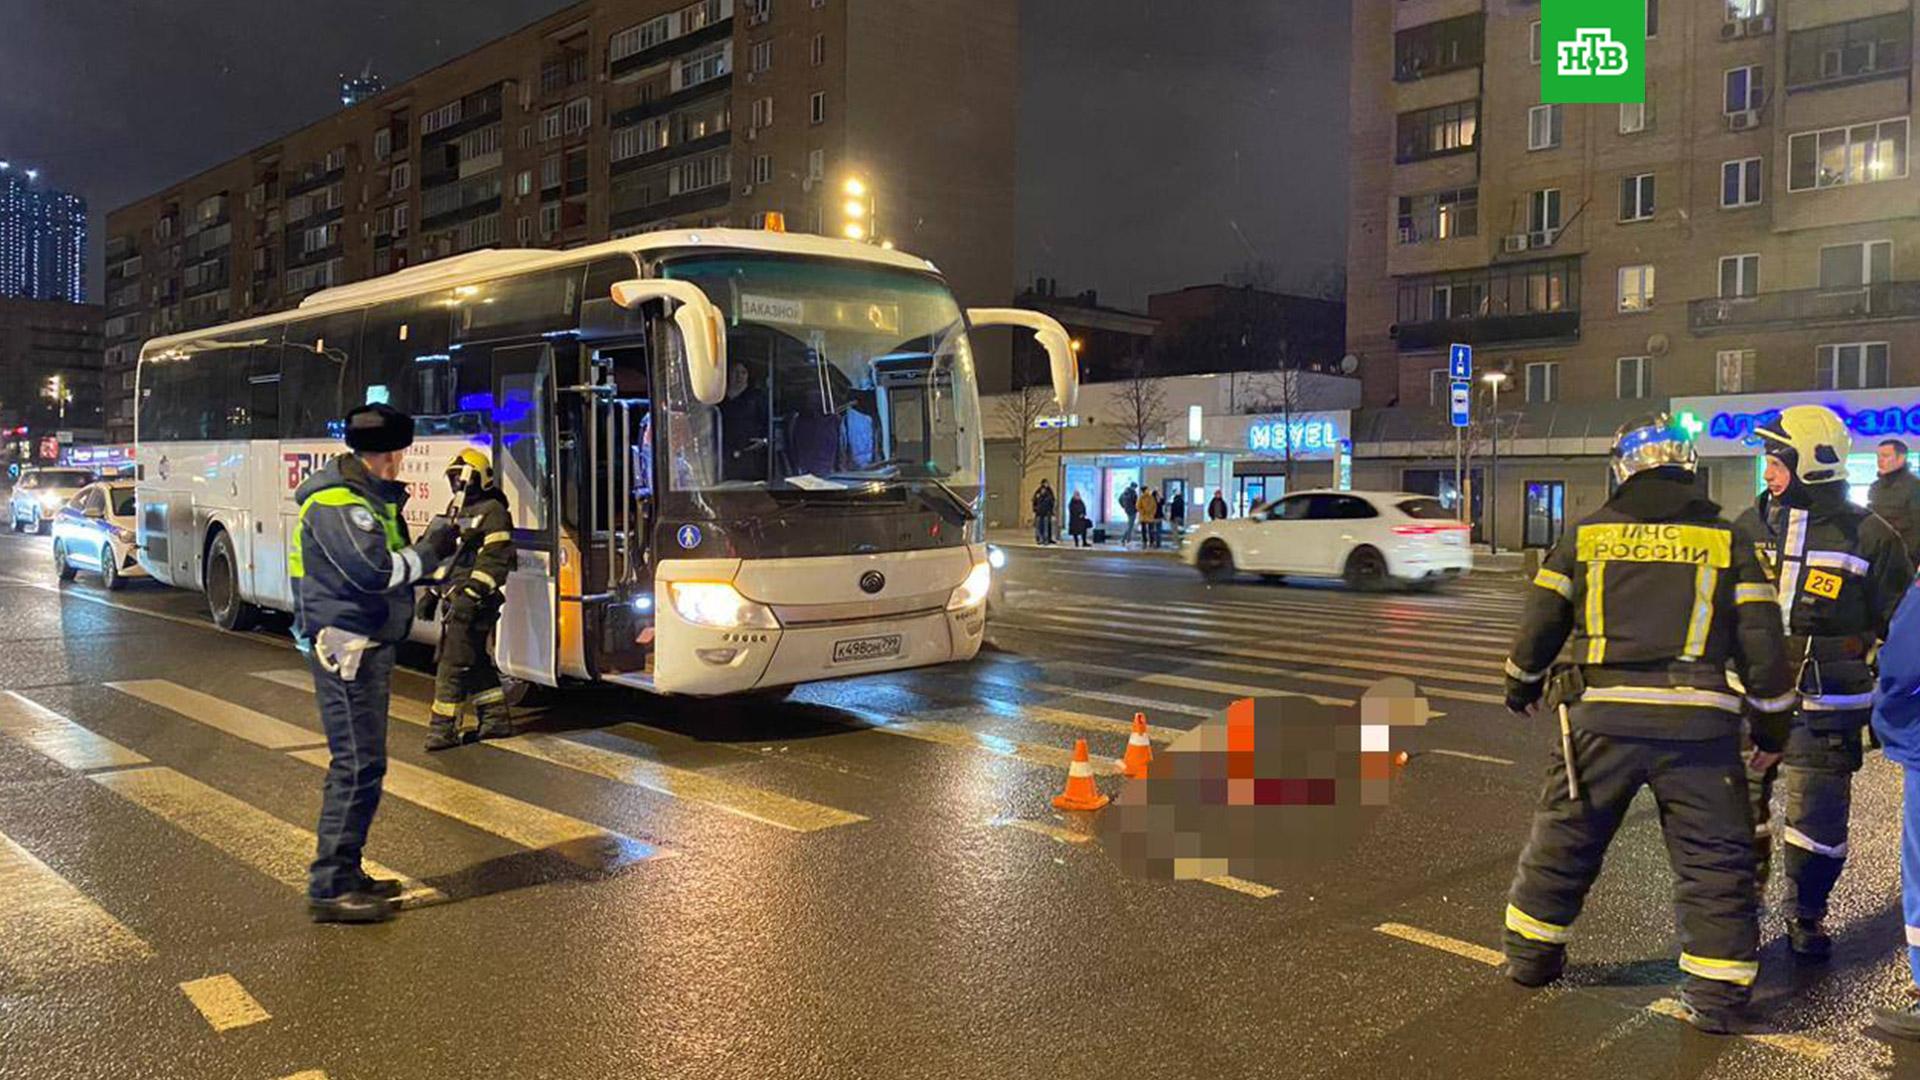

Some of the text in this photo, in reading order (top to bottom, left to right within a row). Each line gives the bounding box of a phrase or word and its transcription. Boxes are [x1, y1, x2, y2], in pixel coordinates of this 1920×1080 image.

[1621, 525, 1681, 540] МЧС
[1594, 543, 1709, 564] РОССИИ
[1811, 575, 1835, 593] 25
